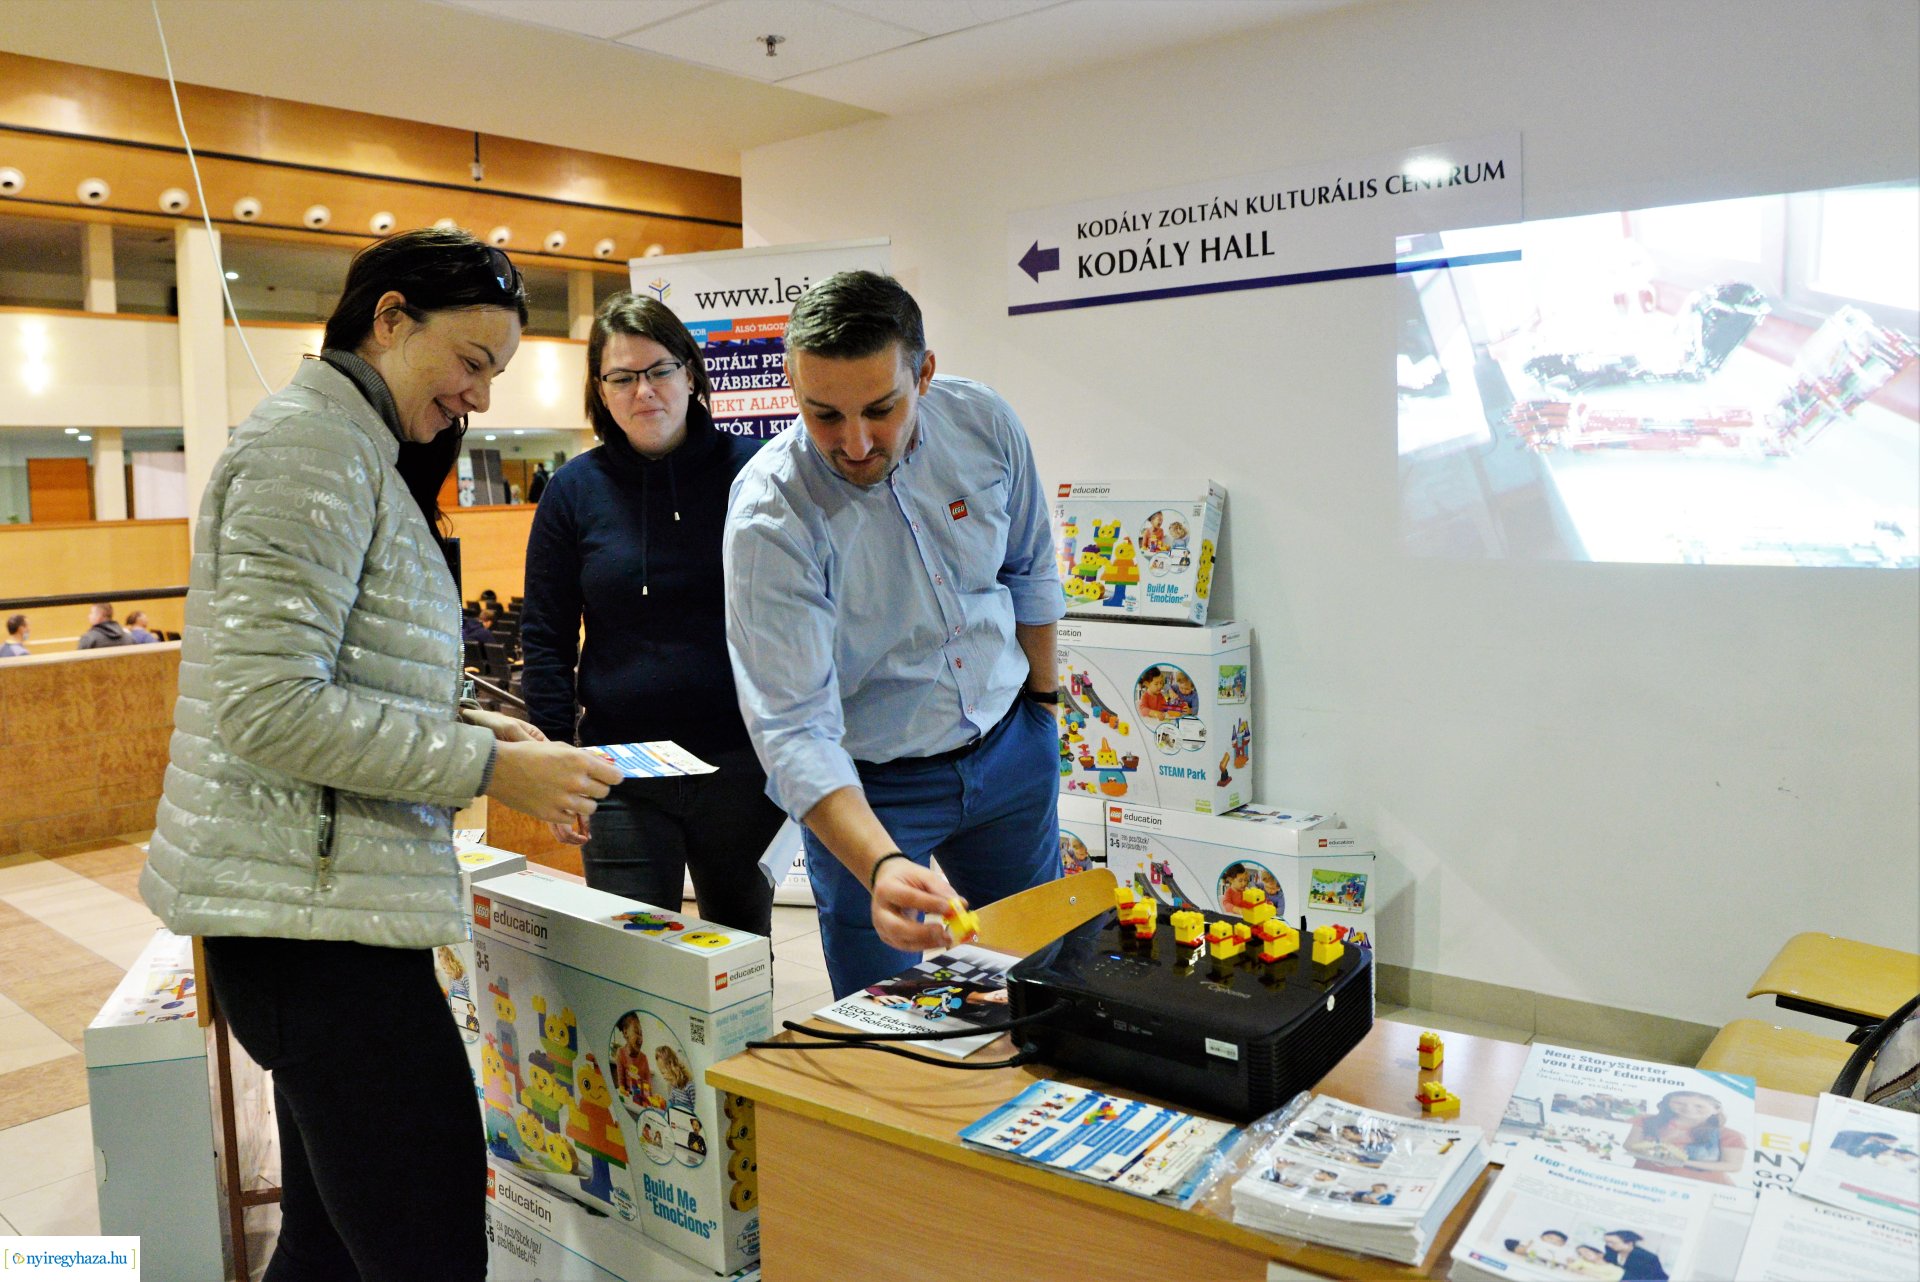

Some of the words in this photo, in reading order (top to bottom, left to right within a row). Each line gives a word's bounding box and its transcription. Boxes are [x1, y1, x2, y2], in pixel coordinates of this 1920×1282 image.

[1077, 211, 1152, 239] KODÁLY
[1159, 197, 1238, 228] ZOLTÁN
[1246, 177, 1378, 215] KULTURÁLIS
[1078, 238, 1190, 279] KODÁLY
[1201, 230, 1275, 263] HALL
[735, 323, 756, 333] ALSÓ
[1072, 486, 1111, 494] education
[1147, 583, 1165, 594] Build
[1167, 584, 1179, 594] Me
[1159, 765, 1185, 778] STEAM
[1187, 768, 1206, 780] Park
[1124, 812, 1162, 825] education
[493, 910, 548, 940] education
[476, 951, 489, 972] 3-5
[729, 963, 765, 981] education
[832, 1008, 860, 1019] 2021
[860, 1016, 906, 1033] Solution
[1542, 1058, 1567, 1068] von
[1613, 1071, 1686, 1087] Education
[1545, 1049, 1575, 1060] Neu:
[1580, 1054, 1667, 1076] StoryStarter
[498, 1183, 552, 1223] education
[643, 1173, 674, 1204] Build
[677, 1188, 697, 1214] Me
